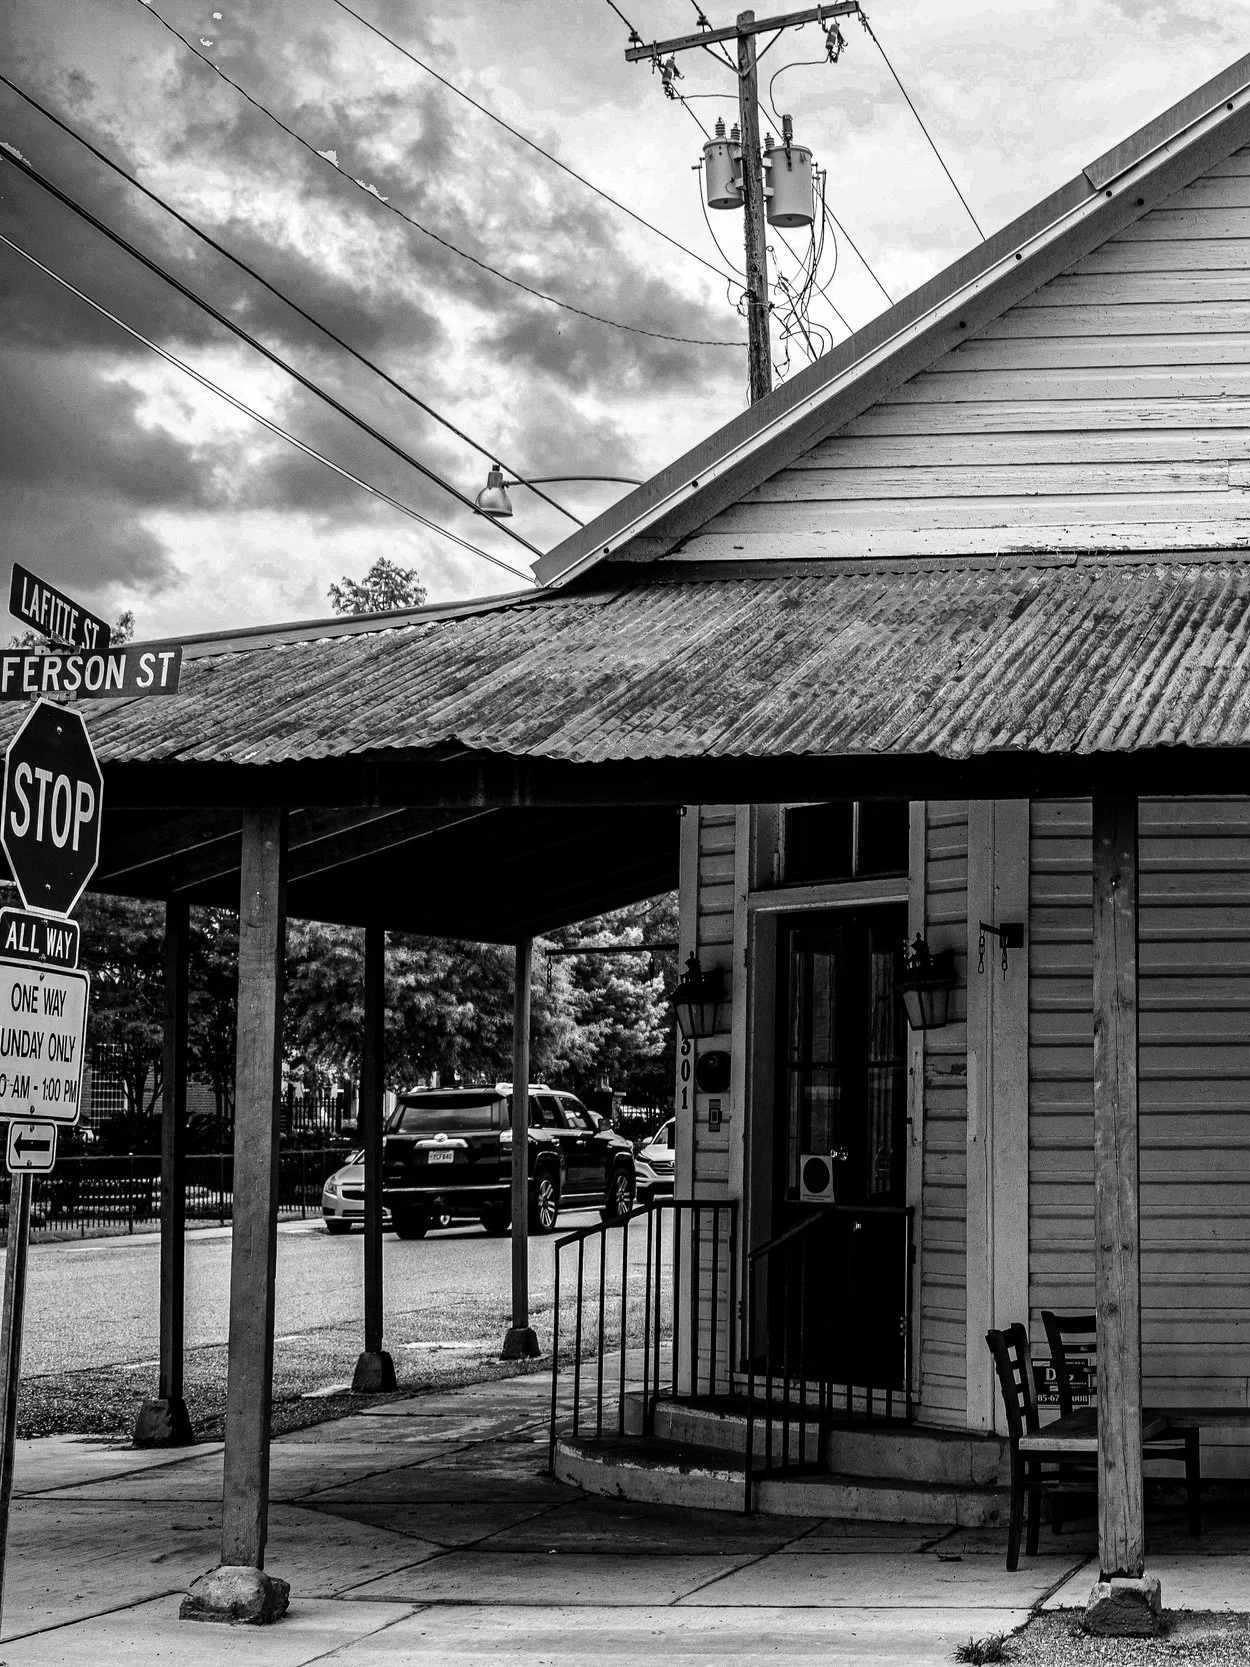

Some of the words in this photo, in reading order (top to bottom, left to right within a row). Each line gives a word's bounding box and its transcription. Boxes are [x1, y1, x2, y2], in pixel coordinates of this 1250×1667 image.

[21, 576, 79, 647] LAFITTE
[81, 618, 100, 649] ST
[1, 655, 127, 693] FERSON
[136, 652, 175, 688] ST
[10, 761, 95, 852] STOP
[5, 920, 40, 954] ALL
[46, 927, 73, 960] WAY
[11, 982, 39, 1014] ONE
[44, 987, 67, 1018] WAY
[0, 1027, 45, 1060] UNDAY
[48, 1032, 77, 1063] ONLY
[11, 1074, 31, 1099] AM
[42, 1077, 61, 1102] 1:00
[63, 1079, 78, 1104] PM
